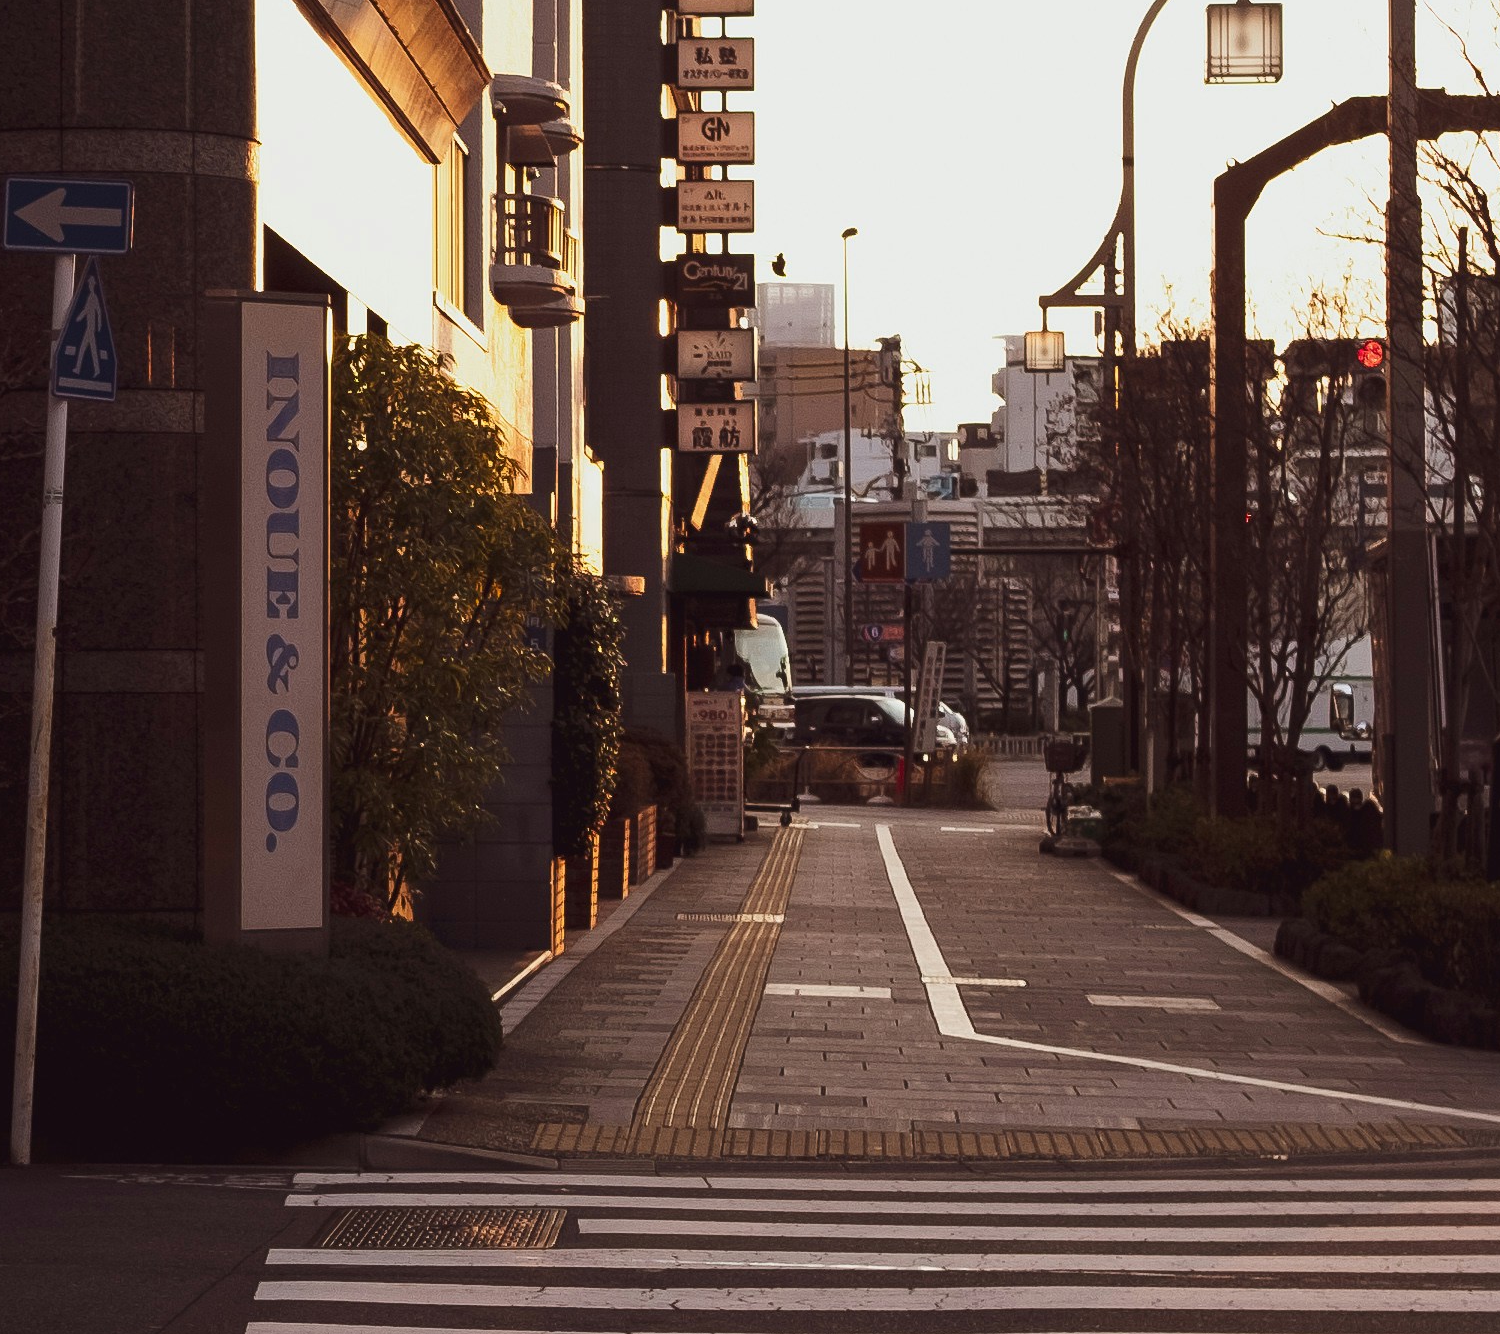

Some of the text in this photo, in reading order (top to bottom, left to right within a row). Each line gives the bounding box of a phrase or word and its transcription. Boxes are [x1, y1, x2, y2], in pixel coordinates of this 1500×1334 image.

[265, 351, 300, 853] INOUE & CO.
